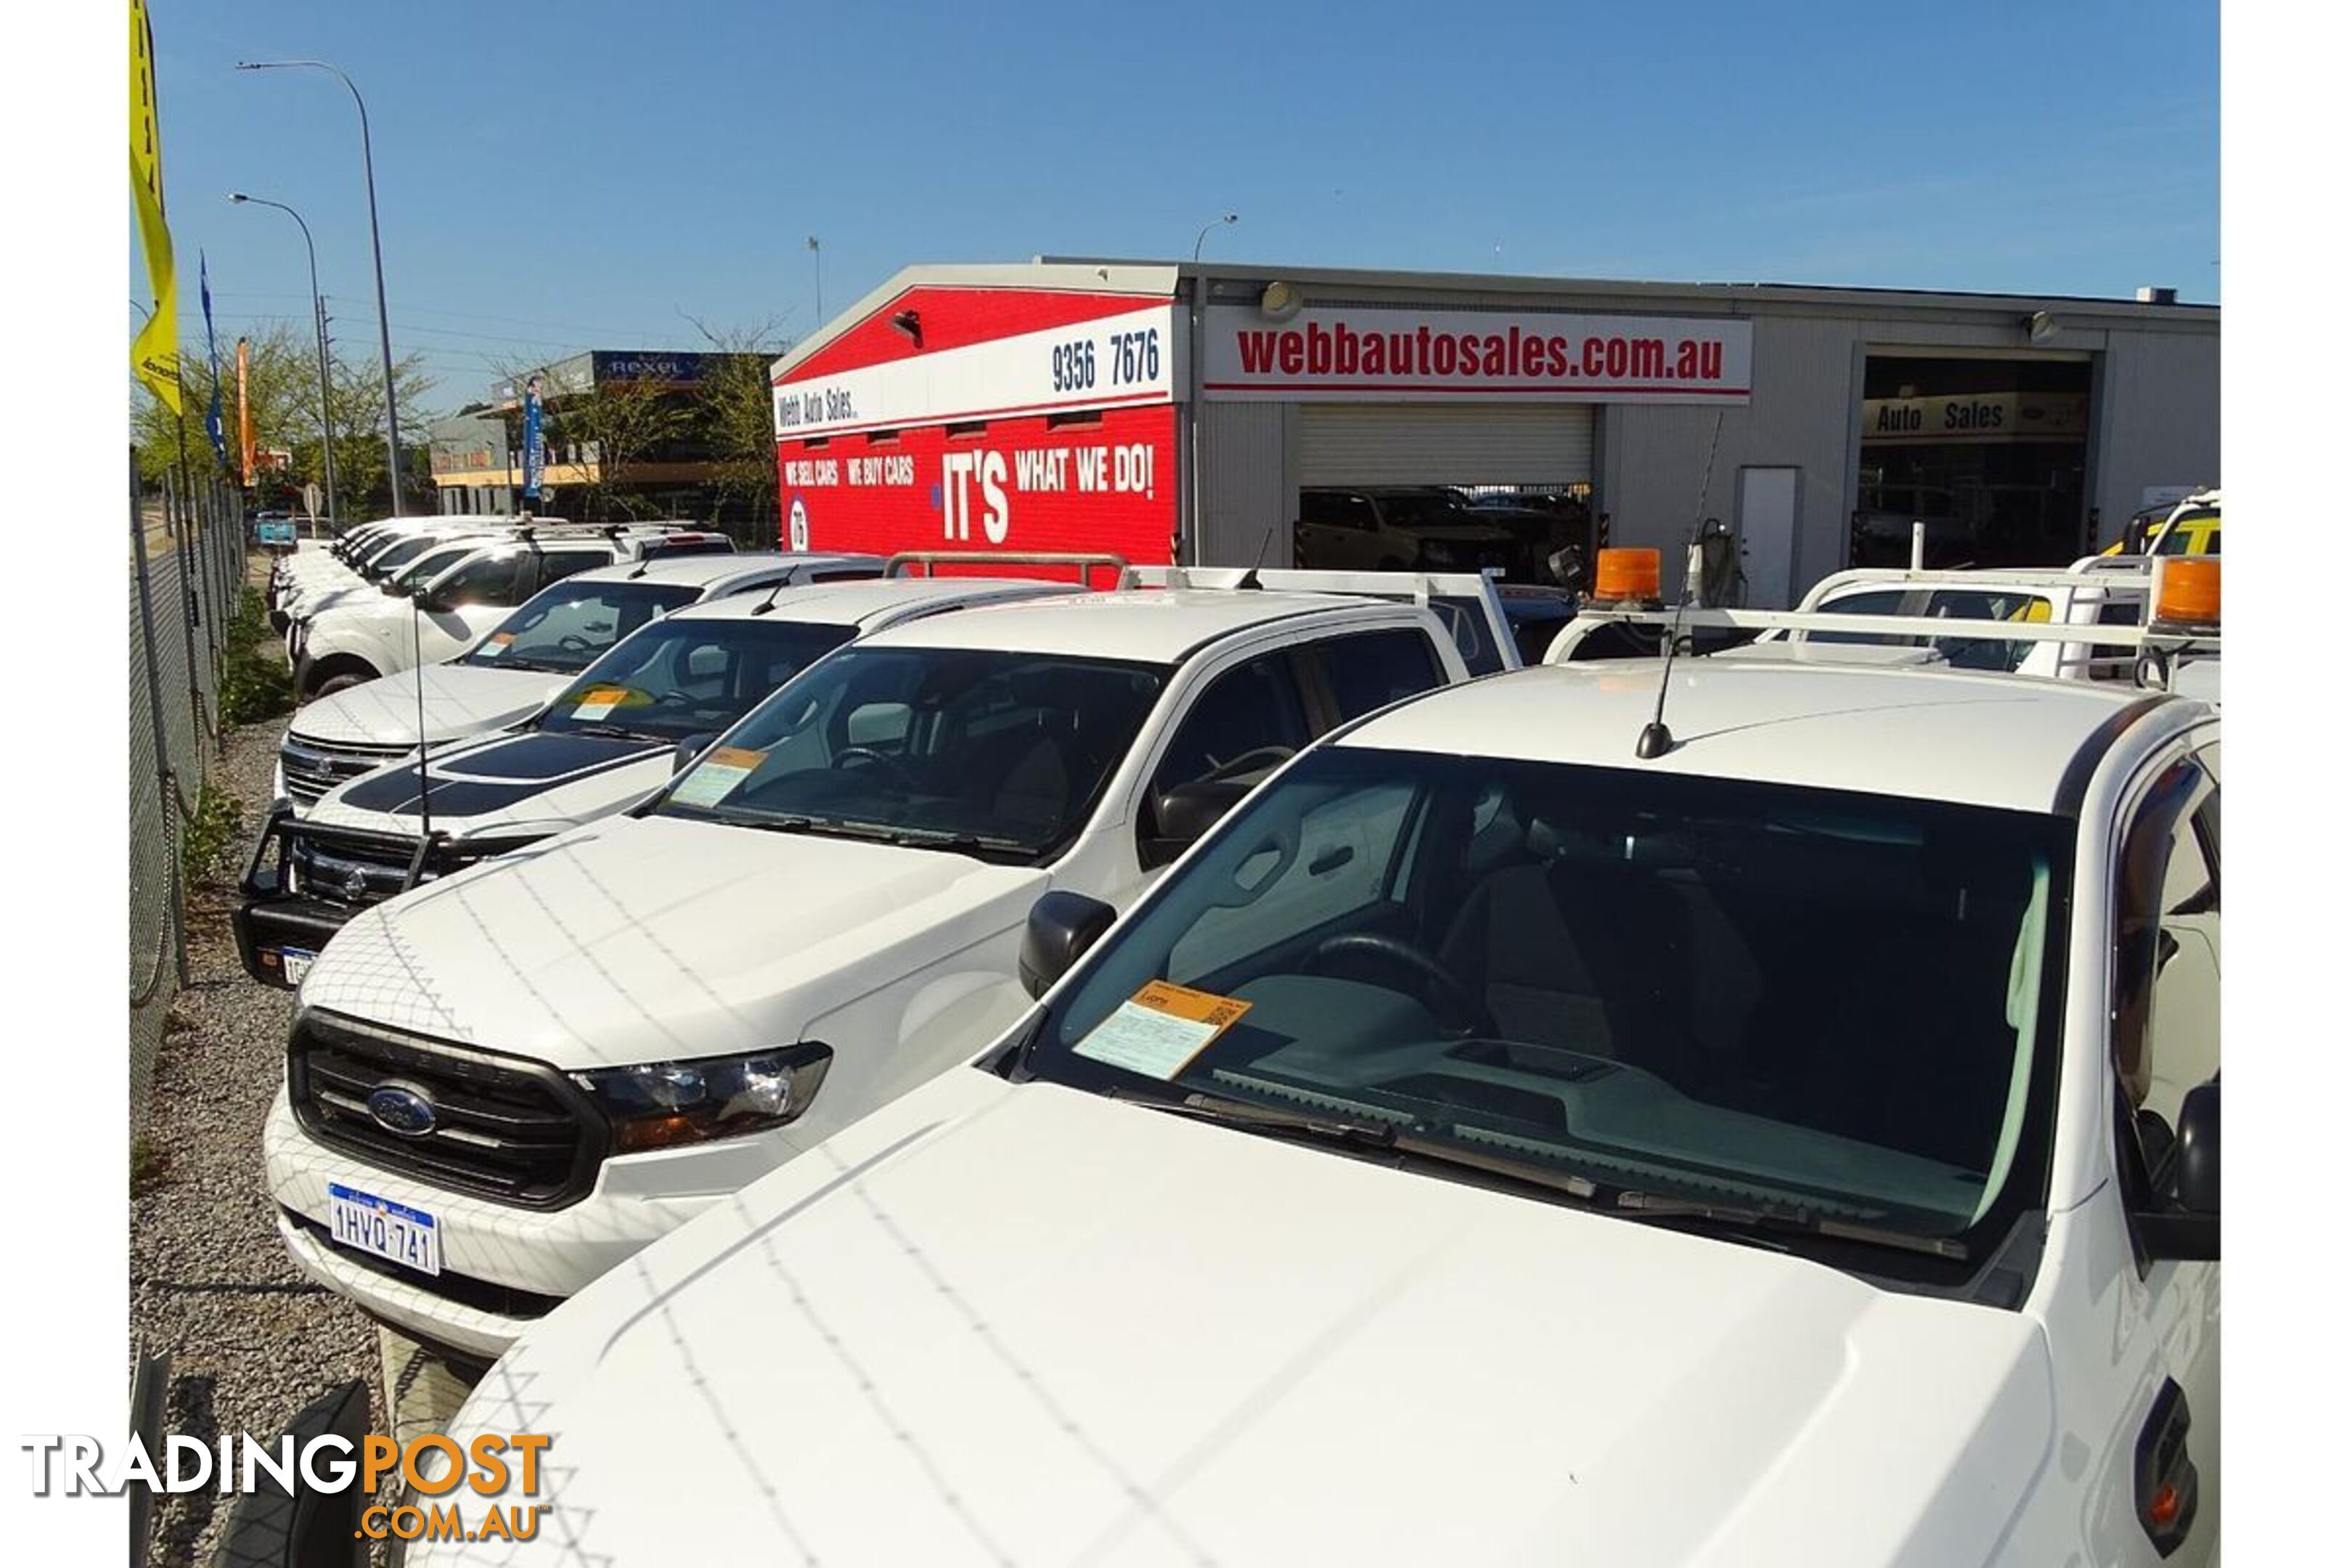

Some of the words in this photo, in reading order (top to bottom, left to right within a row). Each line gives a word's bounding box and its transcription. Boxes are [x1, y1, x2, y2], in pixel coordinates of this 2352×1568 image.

[1053, 339, 1095, 392] 9356
[1111, 327, 1159, 385] 7676
[1238, 322, 1723, 379] webbautosales.com.au
[778, 395, 801, 427] Webb
[804, 393, 822, 423] Auto
[826, 388, 852, 421] Sales
[1877, 404, 1922, 431] Auto
[1943, 401, 2003, 429] Sales
[785, 462, 798, 486] WE
[799, 460, 814, 486] SELL
[815, 459, 839, 486] CARS
[846, 458, 862, 486] WE
[863, 457, 883, 485] BUY
[885, 455, 913, 485] CARS
[943, 449, 1008, 543] IT'S
[1015, 448, 1069, 491] WHAT
[1076, 446, 1107, 491] WE
[1115, 444, 1153, 499] DO!
[337, 1205, 386, 1252] 1HVQ
[396, 1224, 428, 1267] 741
